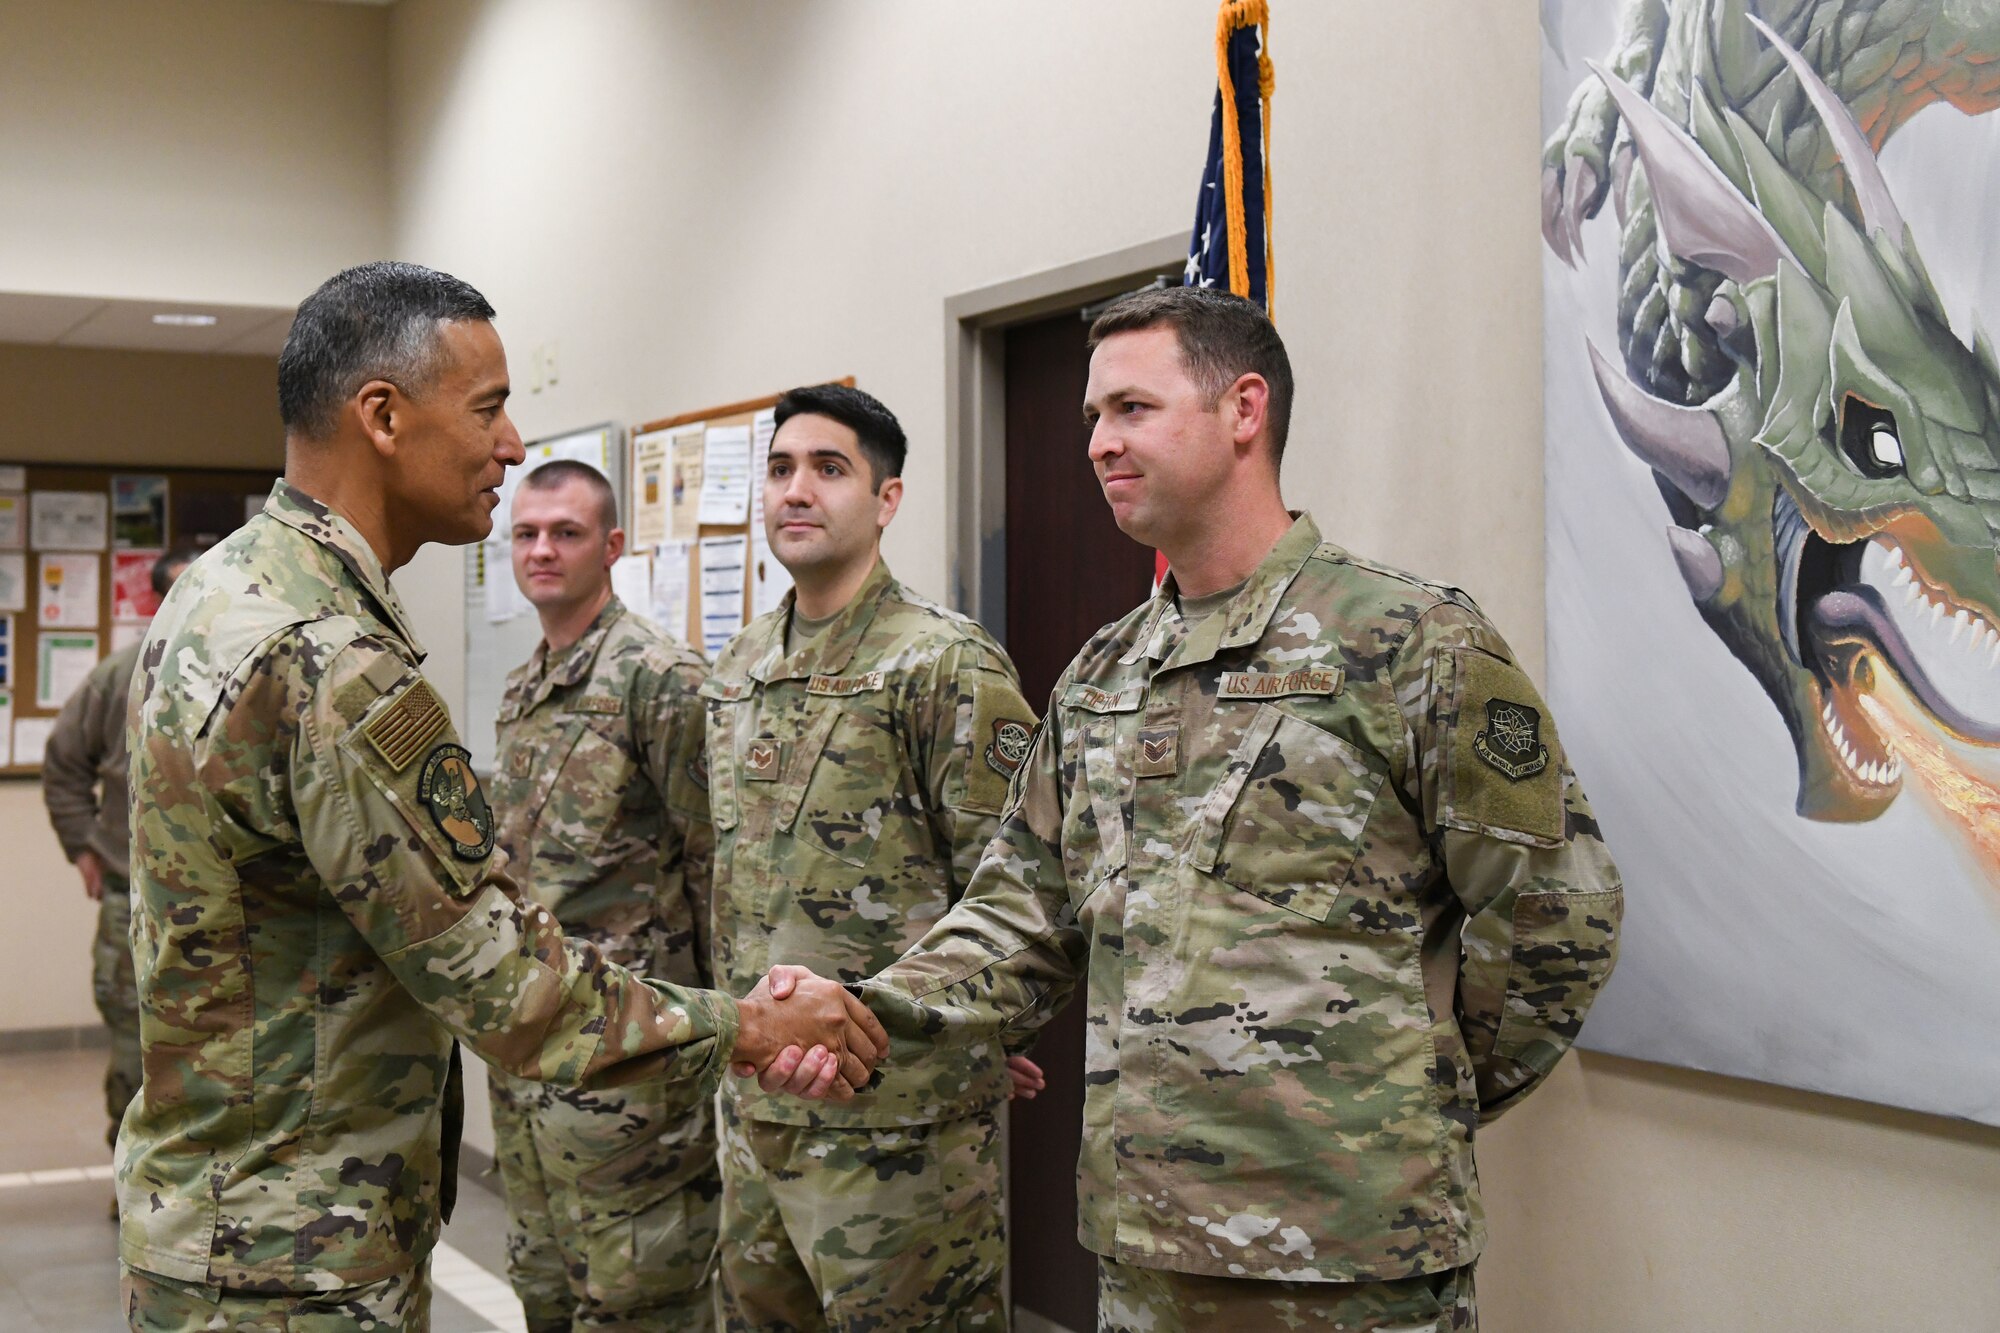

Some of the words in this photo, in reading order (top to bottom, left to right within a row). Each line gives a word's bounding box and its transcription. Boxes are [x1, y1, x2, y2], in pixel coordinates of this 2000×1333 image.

[831, 679, 852, 693] AIR
[1252, 675, 1281, 695] AIR
[1281, 671, 1333, 693] FORCE
